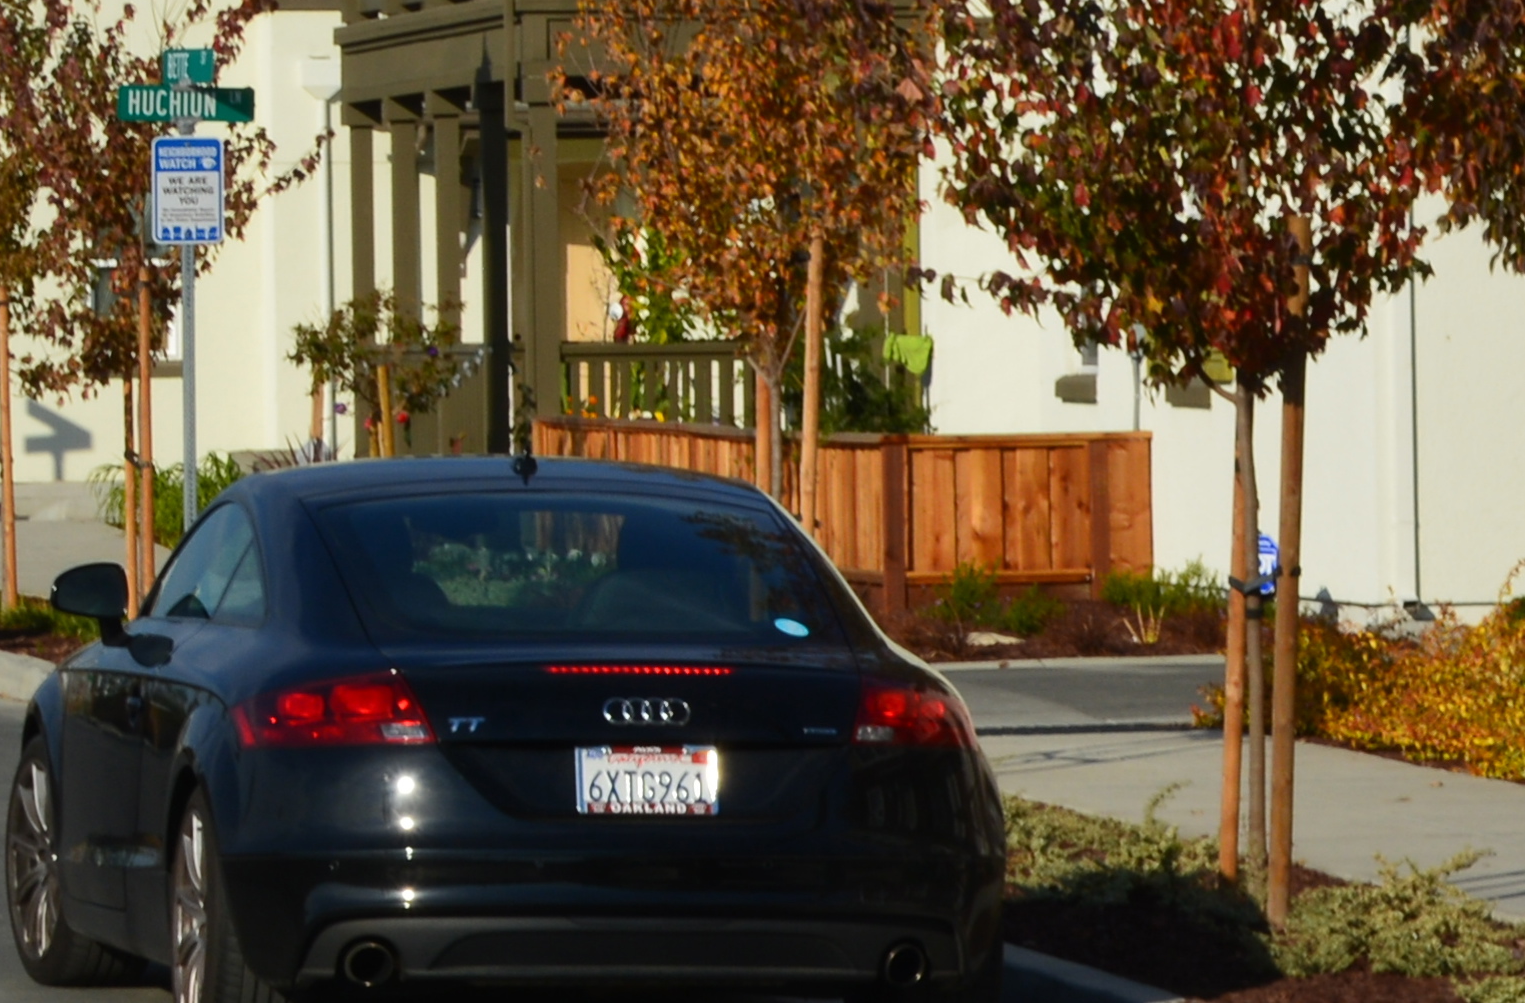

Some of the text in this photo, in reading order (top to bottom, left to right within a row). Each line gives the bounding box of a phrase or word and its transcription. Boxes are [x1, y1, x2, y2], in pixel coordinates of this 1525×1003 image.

[128, 89, 216, 117] HUCHIUN
[158, 158, 196, 169] WATCH
[168, 177, 207, 185] WE ARE
[162, 186, 214, 195] WATCHING
[448, 717, 486, 733] TT
[589, 770, 707, 804] 6XTG961
[610, 802, 687, 814] OAKLAND
